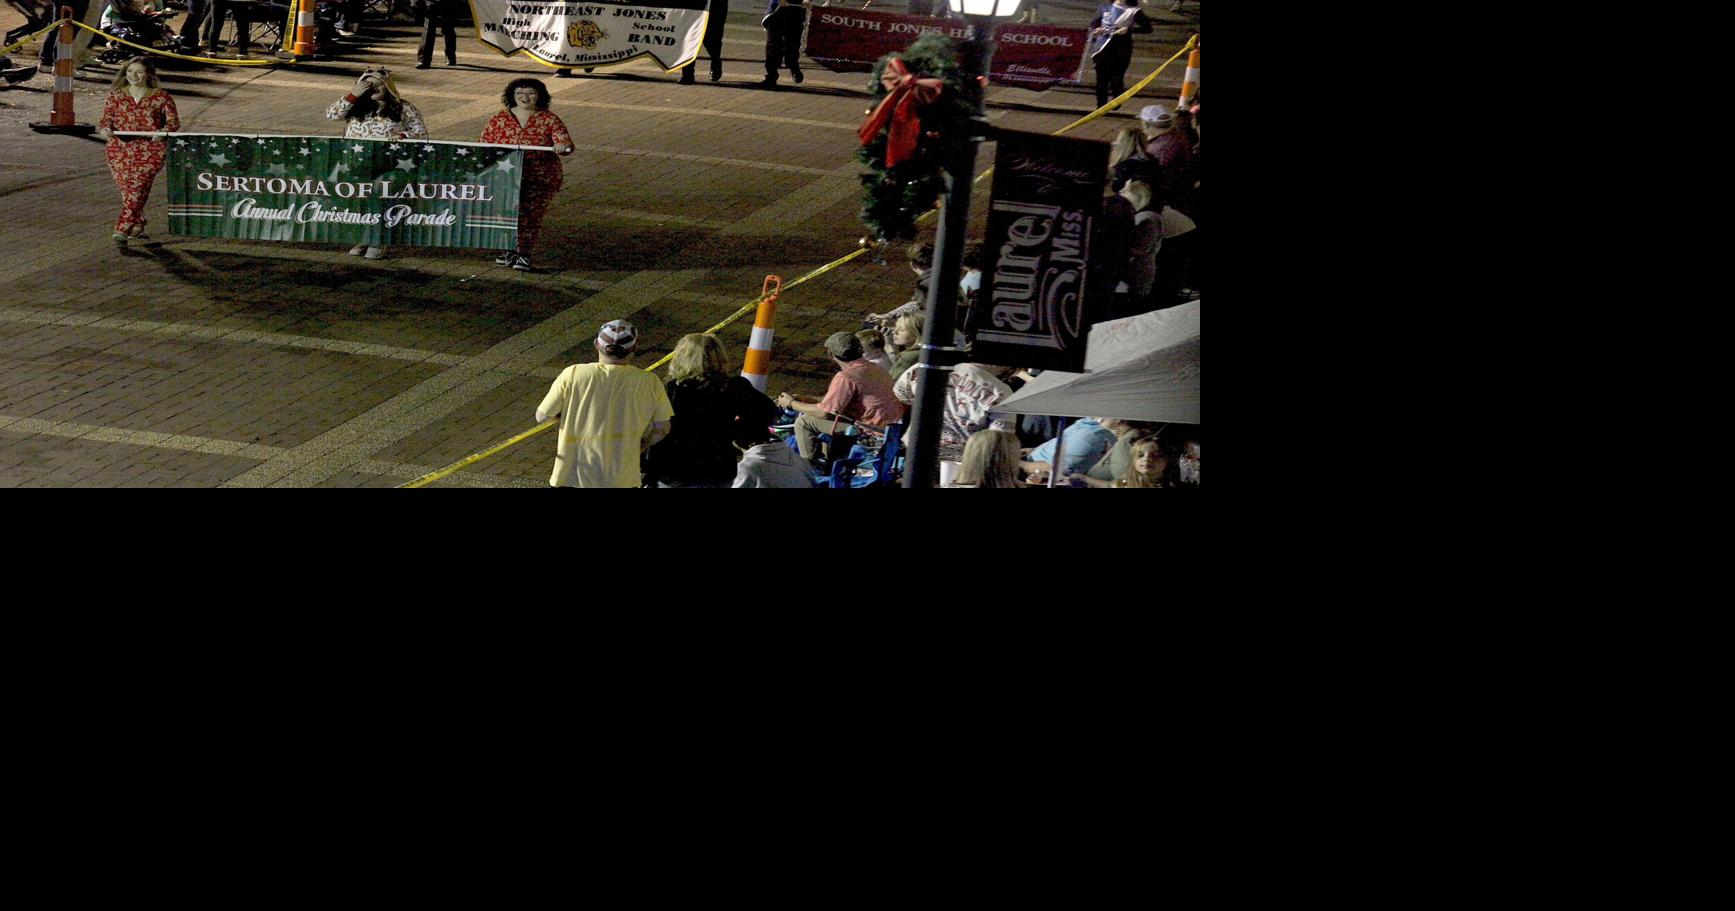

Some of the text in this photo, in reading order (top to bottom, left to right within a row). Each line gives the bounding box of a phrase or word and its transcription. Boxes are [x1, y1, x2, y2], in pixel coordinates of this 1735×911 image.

[502, 17, 676, 33] High School
[509, 4, 667, 20] NORTHEAST JONES
[484, 22, 676, 46] MARCHING BAND
[821, 14, 881, 31] SOUTH
[887, 23, 943, 35] JONES
[1001, 33, 1073, 48] SCHOOL
[532, 45, 638, 61] Laurel, Mississippi
[197, 172, 495, 202] SERTOMA OF LAUREL
[230, 198, 457, 228] Annual Christmas Parade
[975, 200, 1063, 351] Laurel
